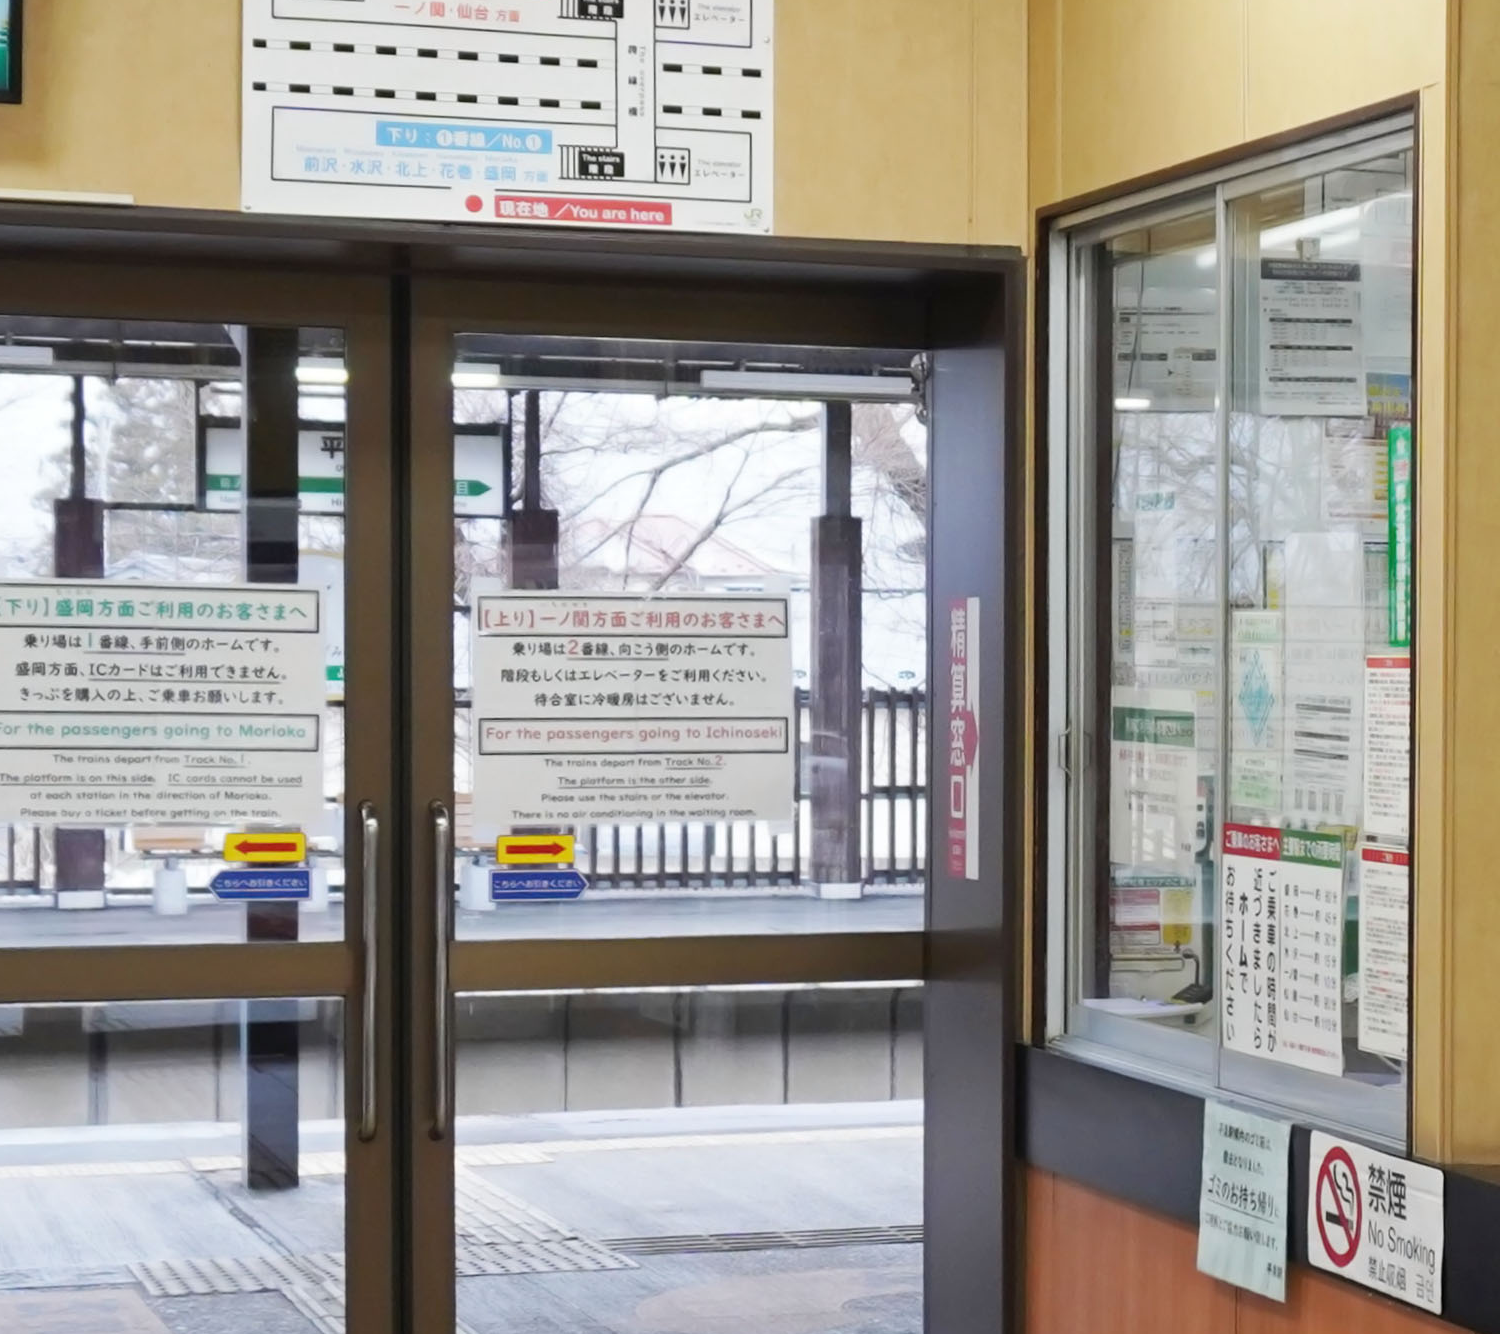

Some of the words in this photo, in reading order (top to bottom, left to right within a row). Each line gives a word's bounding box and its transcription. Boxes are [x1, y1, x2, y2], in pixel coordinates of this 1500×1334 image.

[499, 200, 548, 219] 現在地
[602, 206, 626, 221] are
[630, 206, 664, 222] here
[15, 662, 287, 680] 盛岡方面、ICカードはご利用できません。
[501, 669, 767, 683] 階段もしくはエレベーターをご利用ください。
[19, 688, 284, 705] きっぷを購入の上、ご乗車お願いします。
[534, 692, 735, 707] 待合室に冷暖房はございません。
[28, 723, 55, 736] the
[60, 723, 158, 739] passengers
[163, 724, 210, 739] going
[216, 725, 233, 738] to
[239, 724, 306, 739] Morioka
[486, 728, 512, 740] For
[517, 728, 541, 740] the
[547, 729, 634, 743] passengers
[639, 728, 680, 742] going
[686, 727, 700, 739] to
[706, 725, 783, 739] Ichinoseki
[1368, 1163, 1408, 1221] 禁煙
[1368, 1221, 1384, 1249] No
[1387, 1233, 1436, 1275] Smoking
